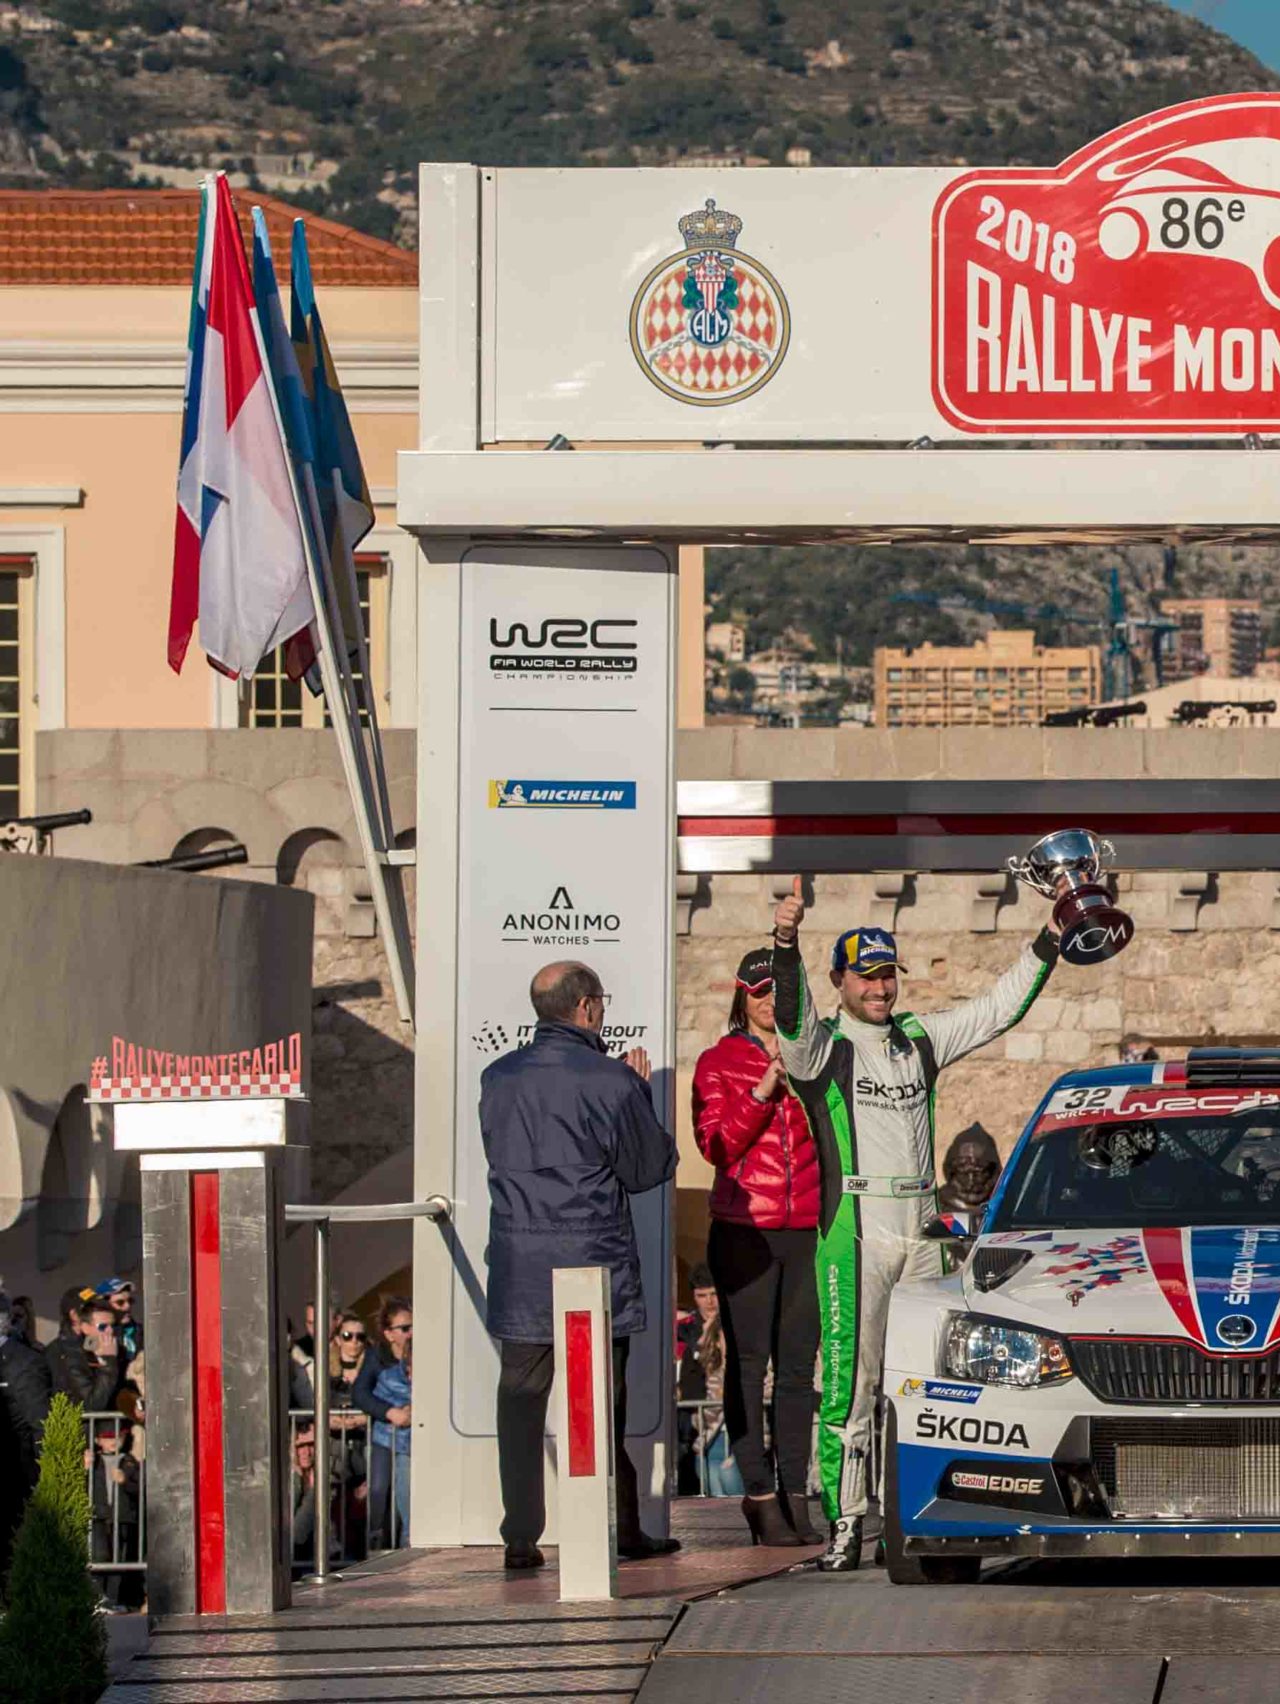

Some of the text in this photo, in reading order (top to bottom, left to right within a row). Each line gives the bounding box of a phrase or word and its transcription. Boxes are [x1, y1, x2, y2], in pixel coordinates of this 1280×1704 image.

[976, 195, 1076, 284] 2018
[966, 259, 1152, 394] RALLYE
[489, 617, 638, 650] WRC
[493, 658, 634, 669] FIA WORLD RALLY
[493, 673, 634, 681] CHAMPIONSHIP
[529, 789, 625, 802] MICHELIN
[502, 913, 621, 931] ANONIMO
[533, 935, 590, 946] WATCHES
[602, 1025, 648, 1038] BOUT
[91, 1032, 301, 1078] #RALLYEMONTECARLO
[1064, 1087, 1112, 1109] 32
[1055, 1109, 1087, 1120] WRC
[1223, 1260, 1255, 1305] ŠKODA
[927, 1385, 981, 1399] MICHELIN
[916, 1407, 1030, 1449] ŠKODA
[960, 1473, 1045, 1495] Castrol EDGE
